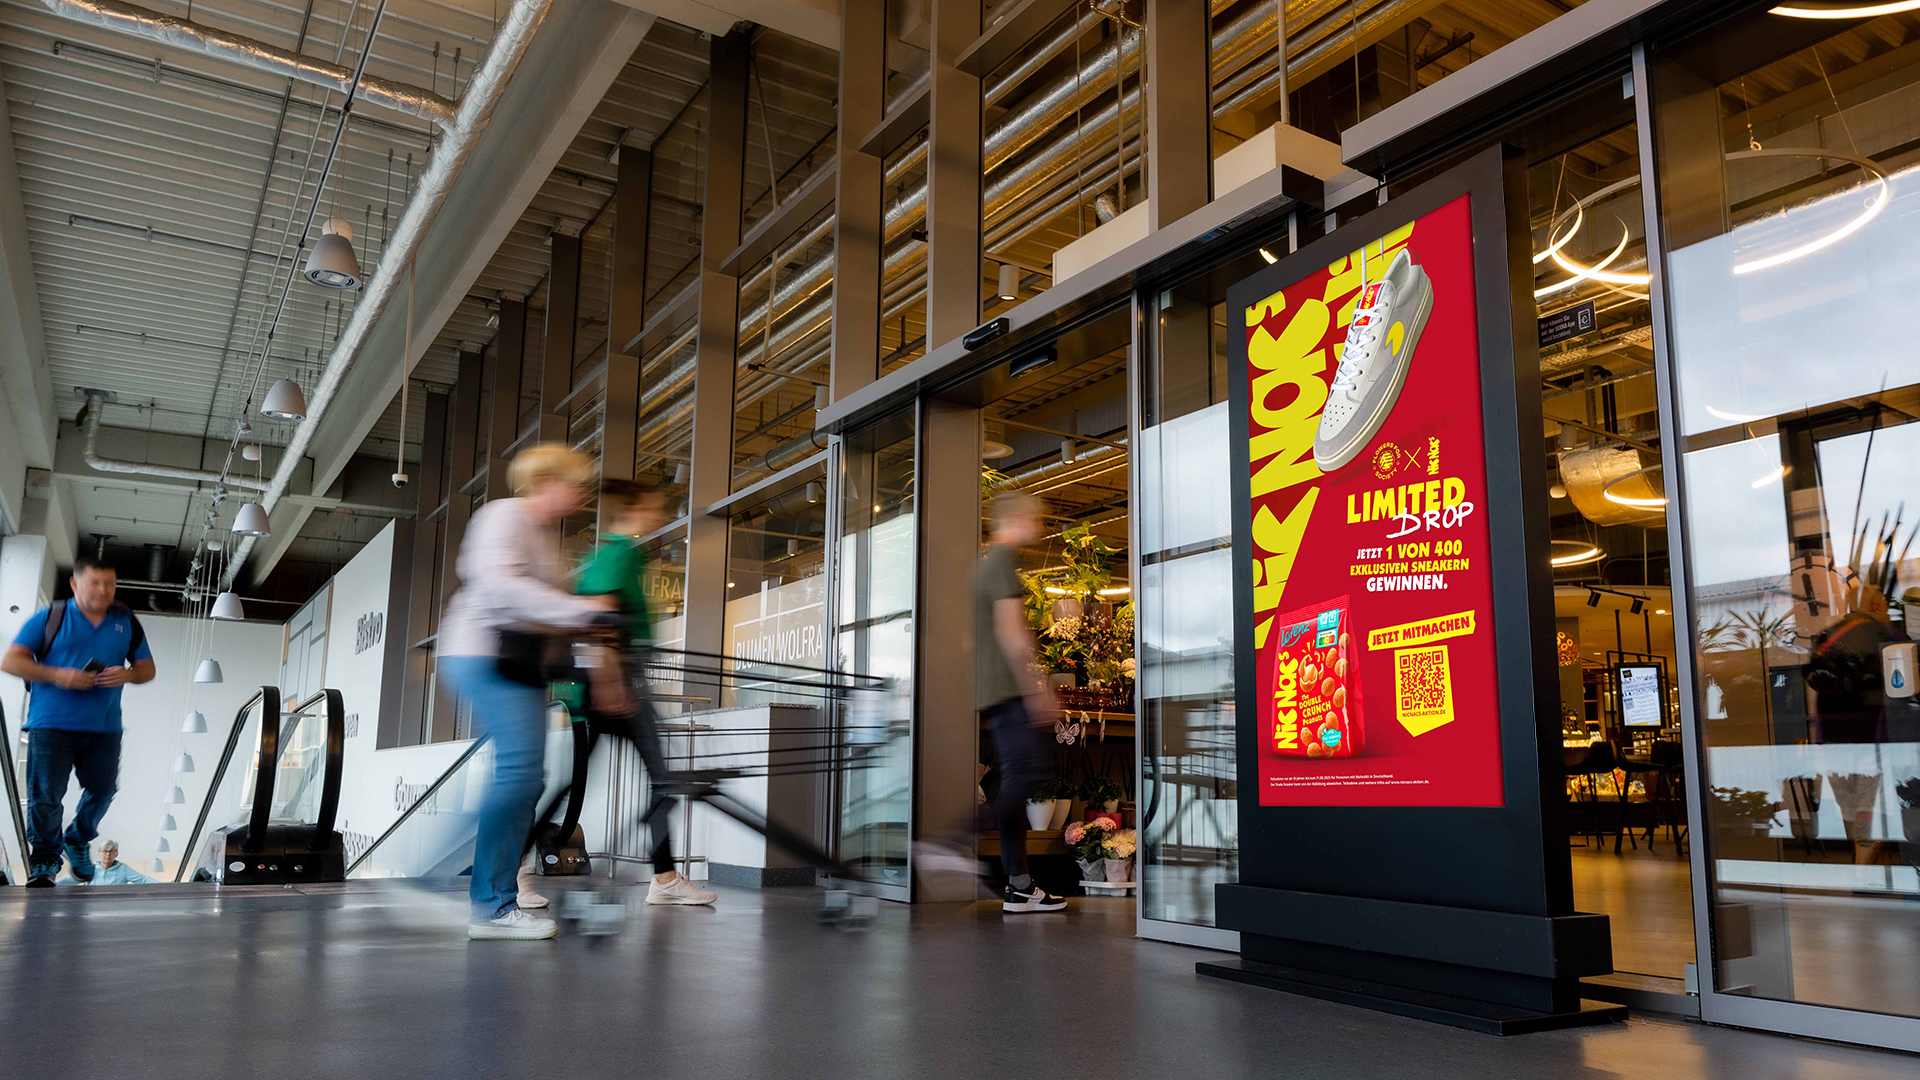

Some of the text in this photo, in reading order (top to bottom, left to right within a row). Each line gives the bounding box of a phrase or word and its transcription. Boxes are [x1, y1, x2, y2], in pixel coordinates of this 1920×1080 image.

[1372, 442, 1401, 464] FLOWERS FOR
[1374, 467, 1397, 480] SOCIETY
[1347, 477, 1465, 524] LIMITED
[1386, 502, 1474, 538] DROP
[1356, 539, 1462, 560] JETZT 1 VON 400
[1350, 558, 1470, 576] EXKLUSIVEN SNEAKERN
[638, 574, 685, 600] LFRA
[1366, 574, 1448, 592] GEWINNEN.
[355, 612, 384, 655] Bistro
[1281, 621, 1310, 647] Lorenz
[1372, 616, 1470, 646] JETZT MITMACHEN
[736, 634, 775, 671] BLUMEN
[1299, 695, 1321, 710] DOUBLE
[1302, 701, 1332, 718] CRUNCH
[1402, 709, 1446, 717] NICNACS-AKTION.DE
[1302, 714, 1323, 726] Peanuts
